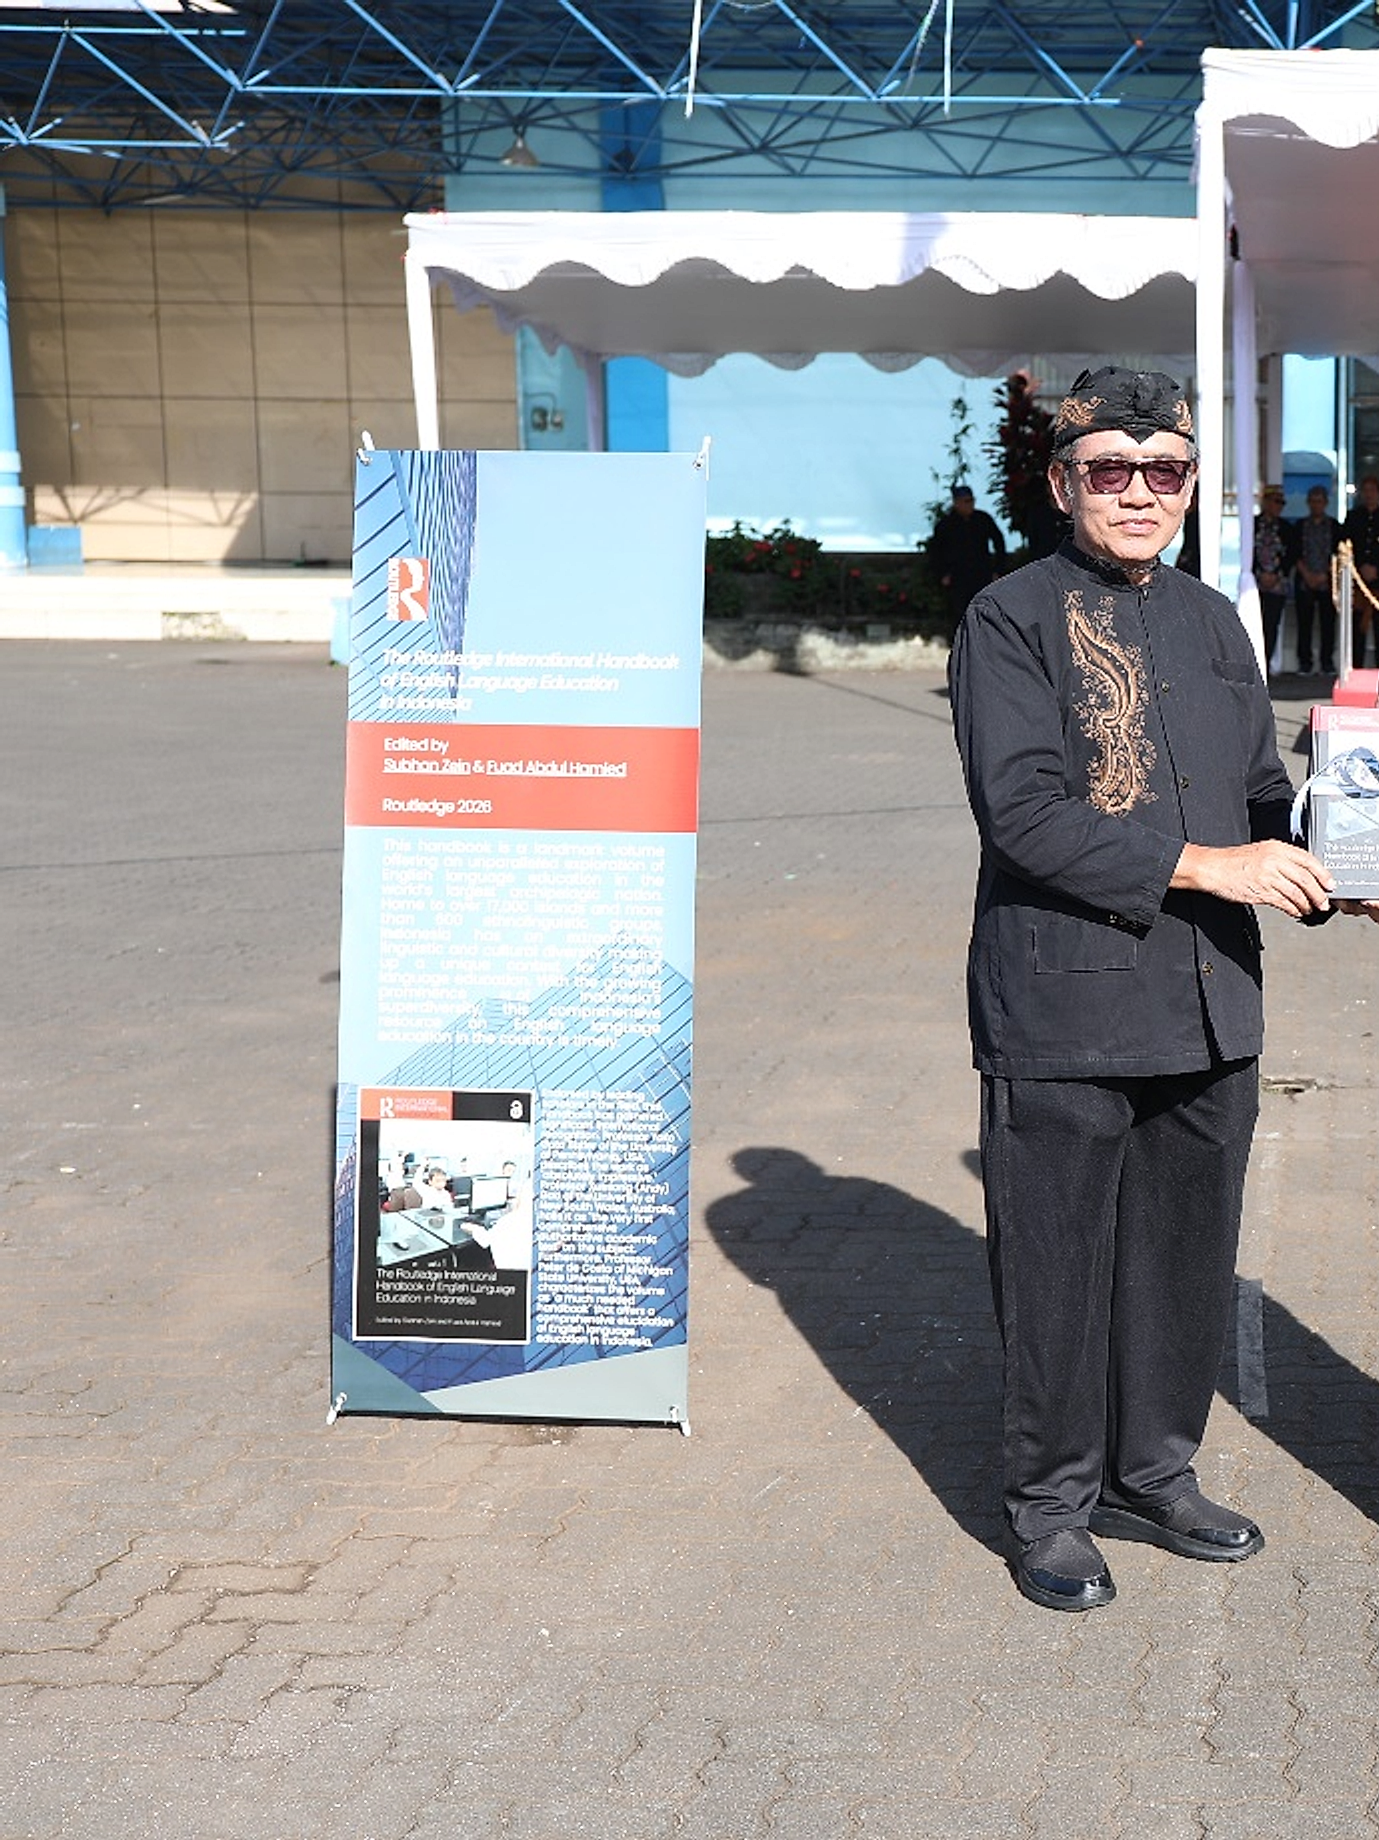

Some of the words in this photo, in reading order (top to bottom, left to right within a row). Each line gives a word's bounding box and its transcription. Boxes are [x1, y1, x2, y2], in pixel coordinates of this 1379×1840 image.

[382, 650, 411, 666] The
[414, 651, 493, 670] Routledge
[495, 652, 595, 668] International
[596, 653, 680, 670] Handbook
[380, 672, 396, 689] of
[398, 673, 455, 692] English
[458, 674, 537, 693] Language
[538, 674, 619, 691] Education
[380, 694, 394, 709] in
[396, 695, 473, 711] Indonesia
[384, 738, 428, 751] Edited
[430, 738, 449, 755] by
[382, 758, 438, 773] Subhan
[441, 758, 471, 774] Zein
[472, 760, 485, 773] &
[486, 760, 523, 775] Fuad
[523, 760, 568, 776] Abdul
[570, 762, 627, 777] Hamied
[382, 798, 455, 816] Routledge
[456, 800, 492, 813] 2026
[376, 1268, 394, 1279] The
[396, 1268, 443, 1281] Routledge
[444, 1270, 498, 1282] International
[376, 1280, 424, 1291] Handbook
[426, 1281, 436, 1291] of
[436, 1282, 469, 1294] English
[470, 1283, 516, 1296] Language
[376, 1292, 421, 1303] Education
[424, 1294, 433, 1303] in
[434, 1294, 477, 1305] Indonesia
